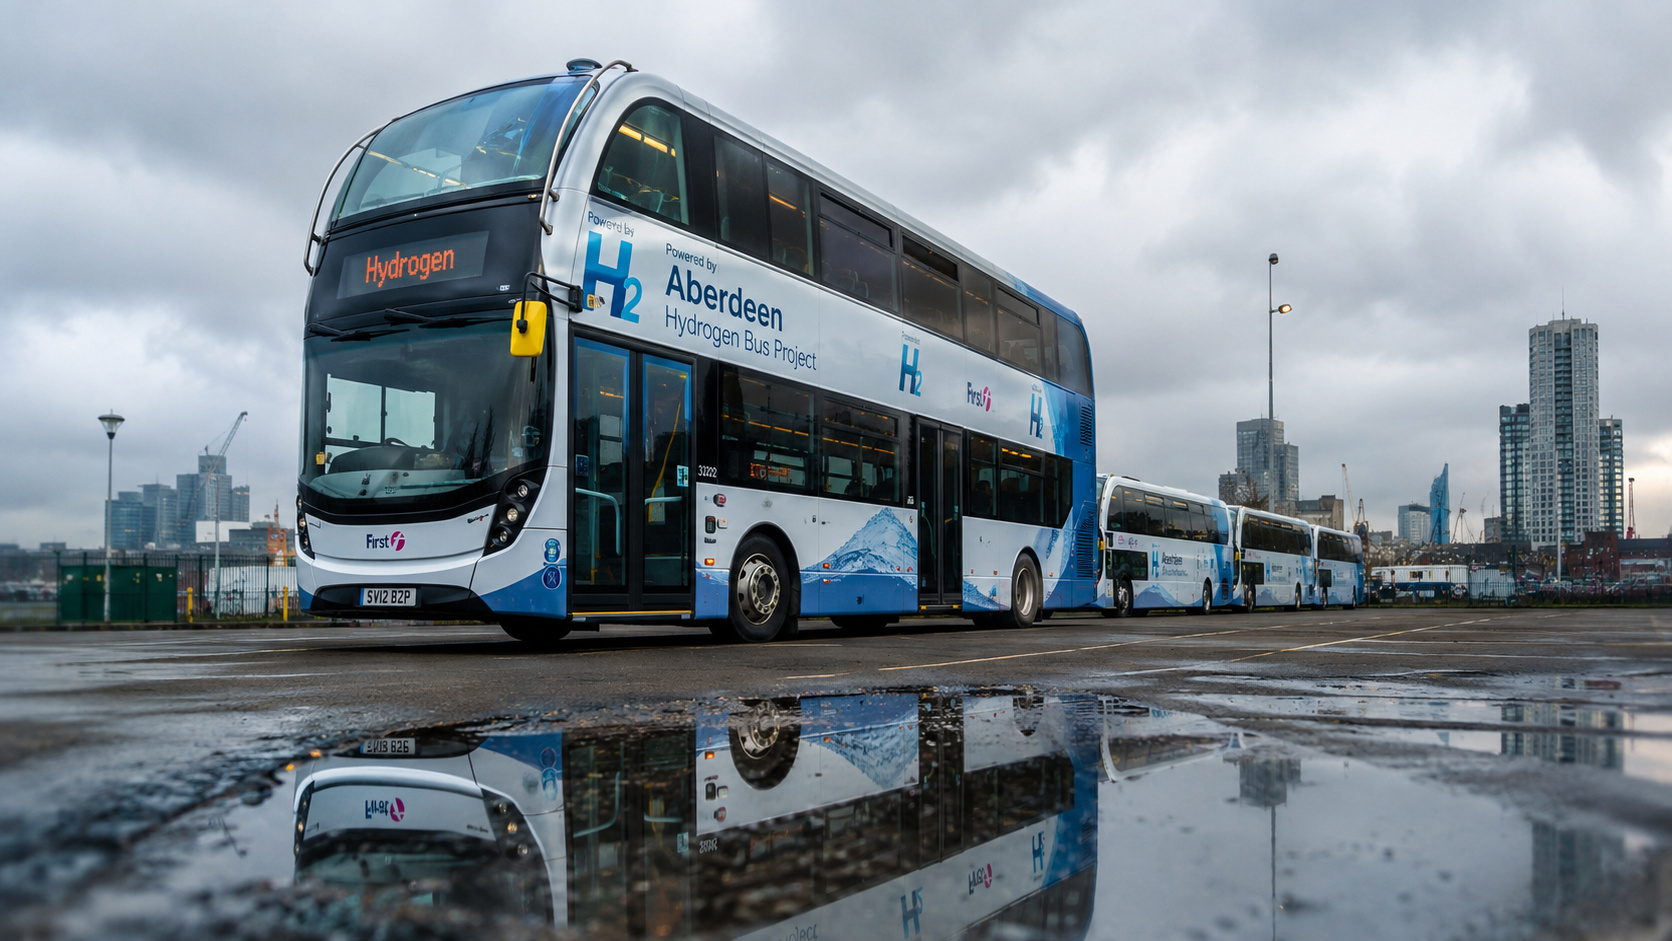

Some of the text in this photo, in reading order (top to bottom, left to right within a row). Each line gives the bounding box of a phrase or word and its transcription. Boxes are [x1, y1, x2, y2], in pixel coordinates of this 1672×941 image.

[365, 249, 454, 288] Hydrogen
[666, 243, 717, 273] Powered by
[665, 265, 783, 332] Aberdeen
[665, 304, 817, 371] Hydrogen Bus Project
[366, 533, 390, 549] First
[367, 590, 389, 604] SV12
